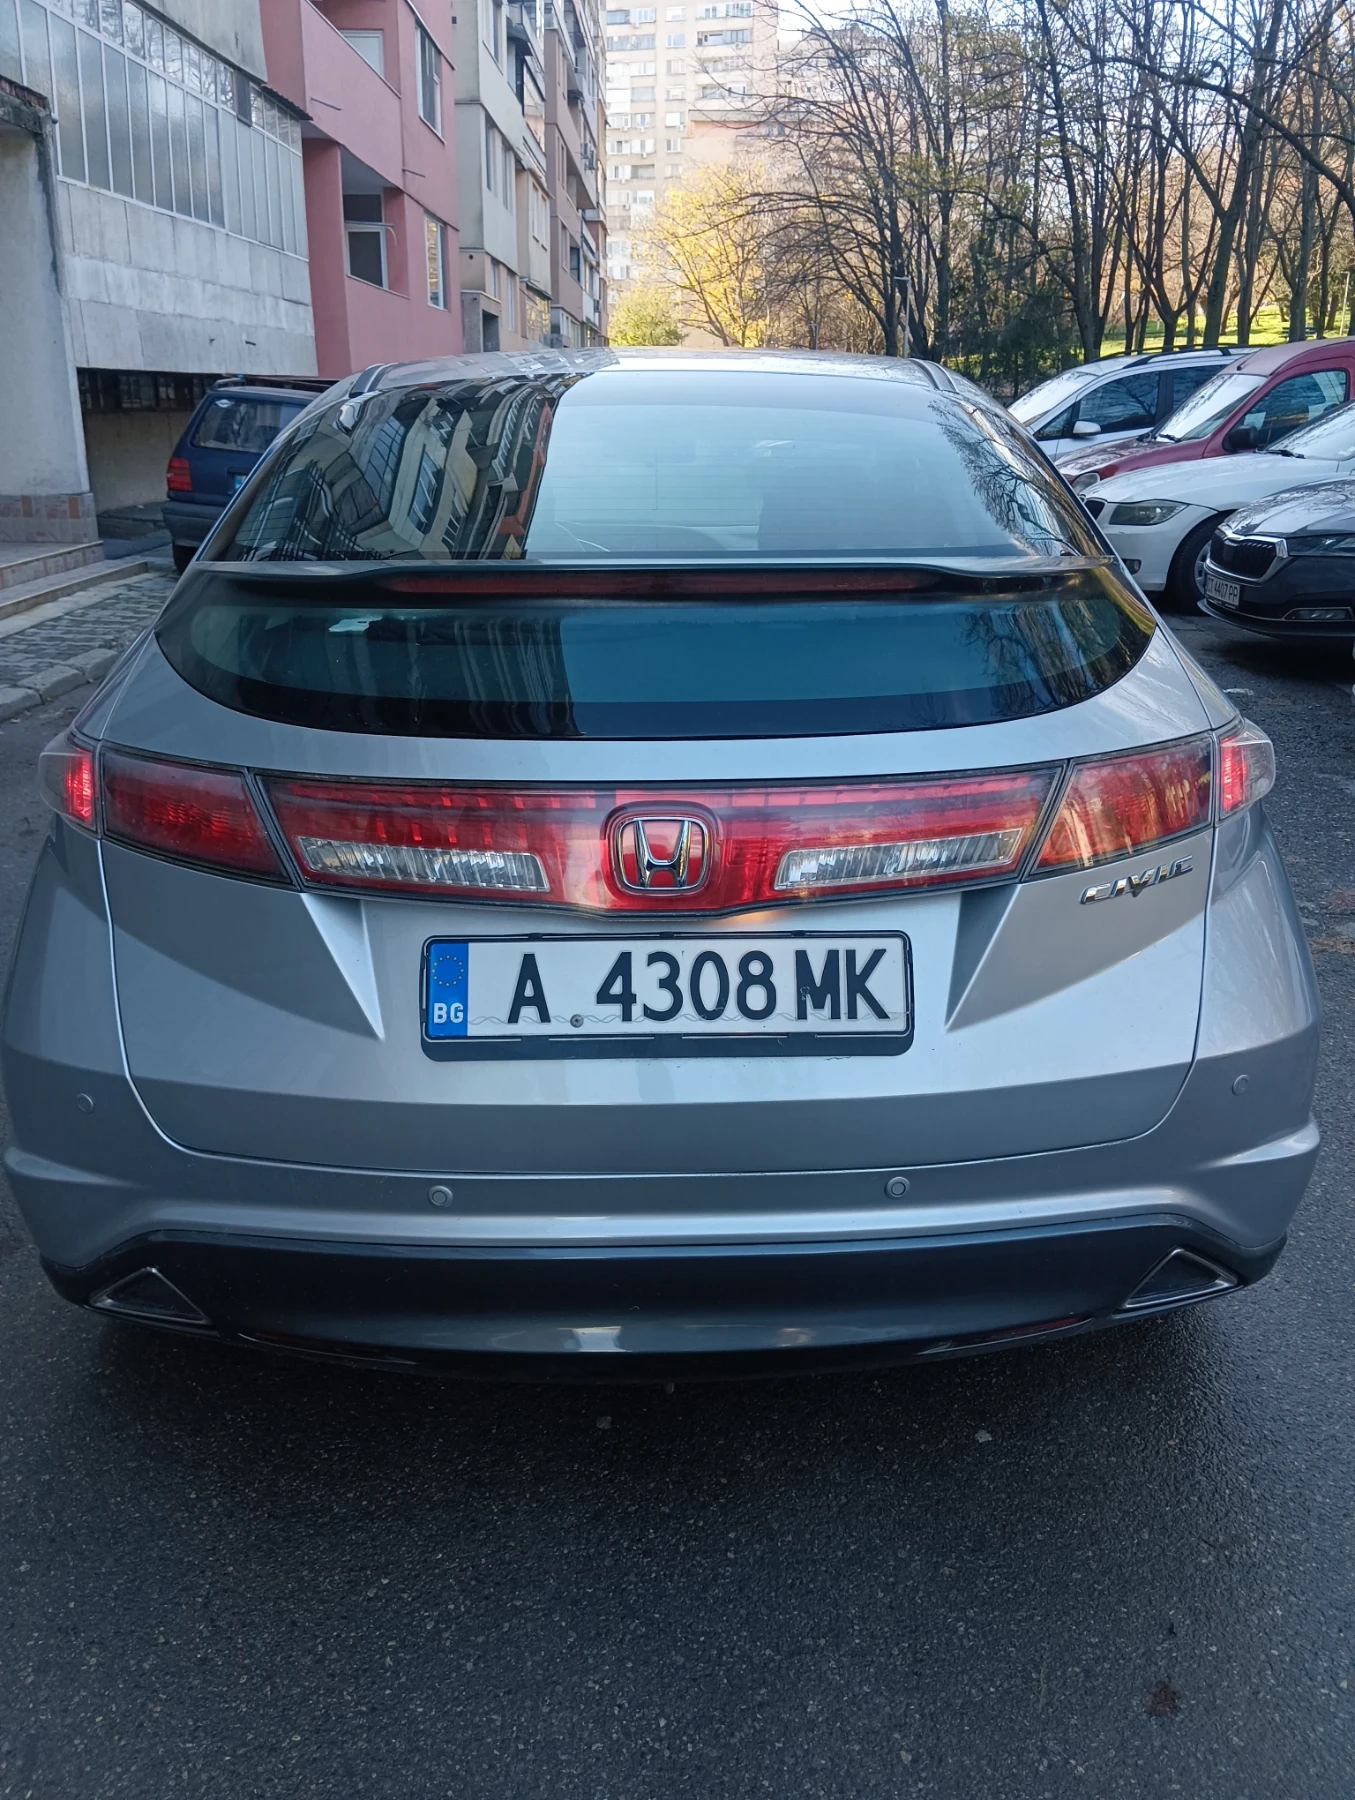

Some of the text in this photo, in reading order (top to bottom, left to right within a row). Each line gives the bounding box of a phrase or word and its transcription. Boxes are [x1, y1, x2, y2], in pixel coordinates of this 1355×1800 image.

[1229, 585, 1239, 602] PP
[1079, 855, 1193, 904] CIVIC
[508, 949, 891, 1024] A 4308 MK
[433, 1003, 464, 1024] BG
